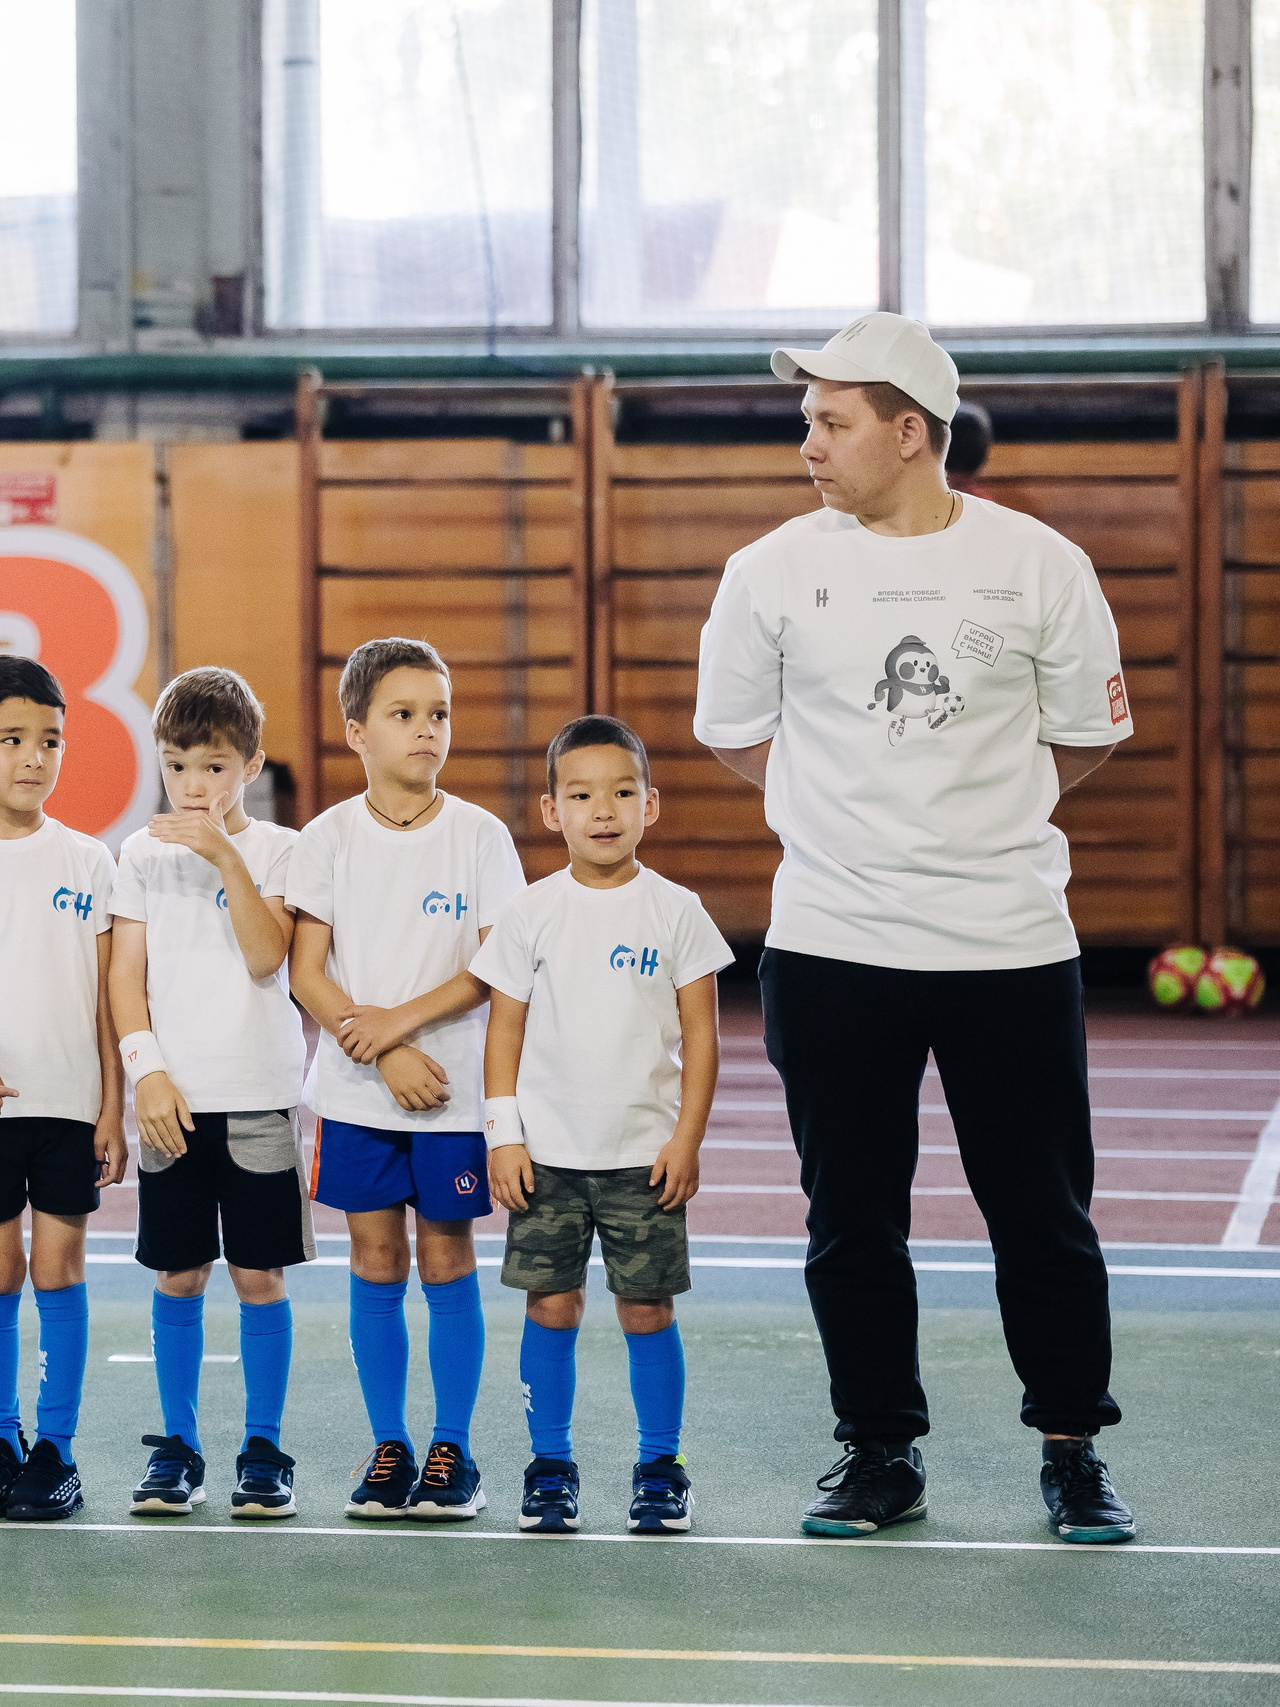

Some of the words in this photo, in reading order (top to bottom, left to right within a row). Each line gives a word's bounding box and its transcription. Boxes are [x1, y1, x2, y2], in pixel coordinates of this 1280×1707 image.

[973, 588, 1023, 597] МАГНИТОГОРСК
[969, 627, 995, 644] ИГРАЙ
[963, 634, 995, 653] ВМЕСТЕ
[966, 644, 992, 660] НАМИ!
[127, 1050, 138, 1063] 17
[486, 1119, 495, 1131] 17
